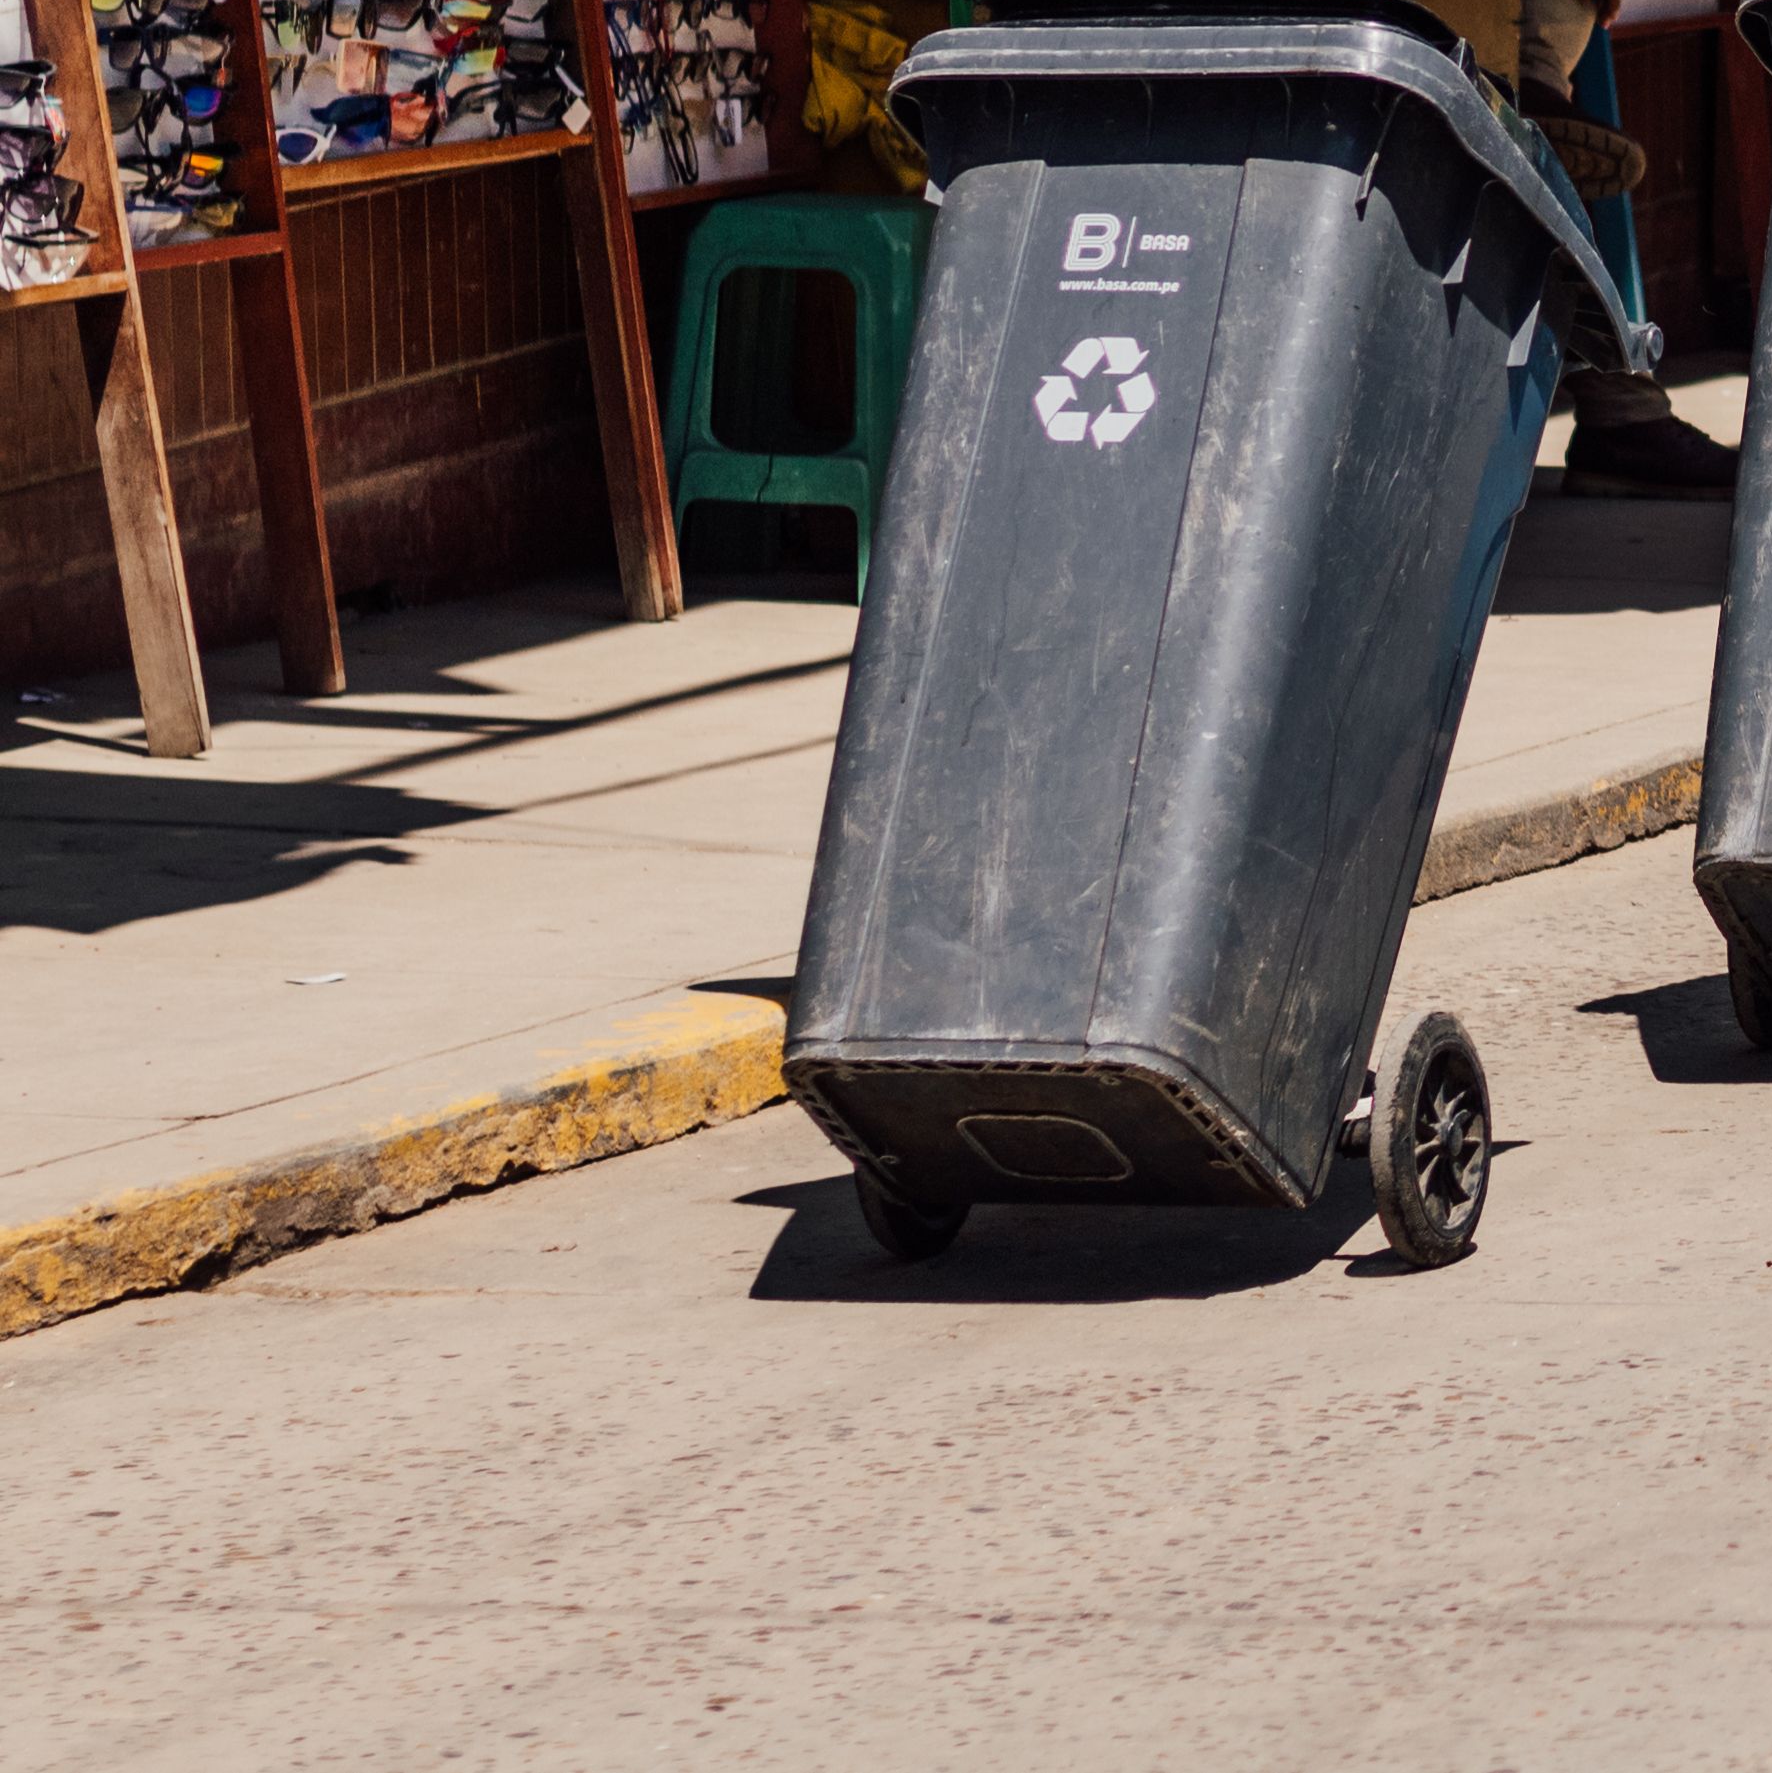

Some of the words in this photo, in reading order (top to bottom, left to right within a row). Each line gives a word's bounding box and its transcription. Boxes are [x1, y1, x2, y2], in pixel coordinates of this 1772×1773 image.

[1063, 213, 1121, 272] B
[1139, 234, 1190, 251] BASA
[1058, 278, 1181, 294] www.basa.com.pe
